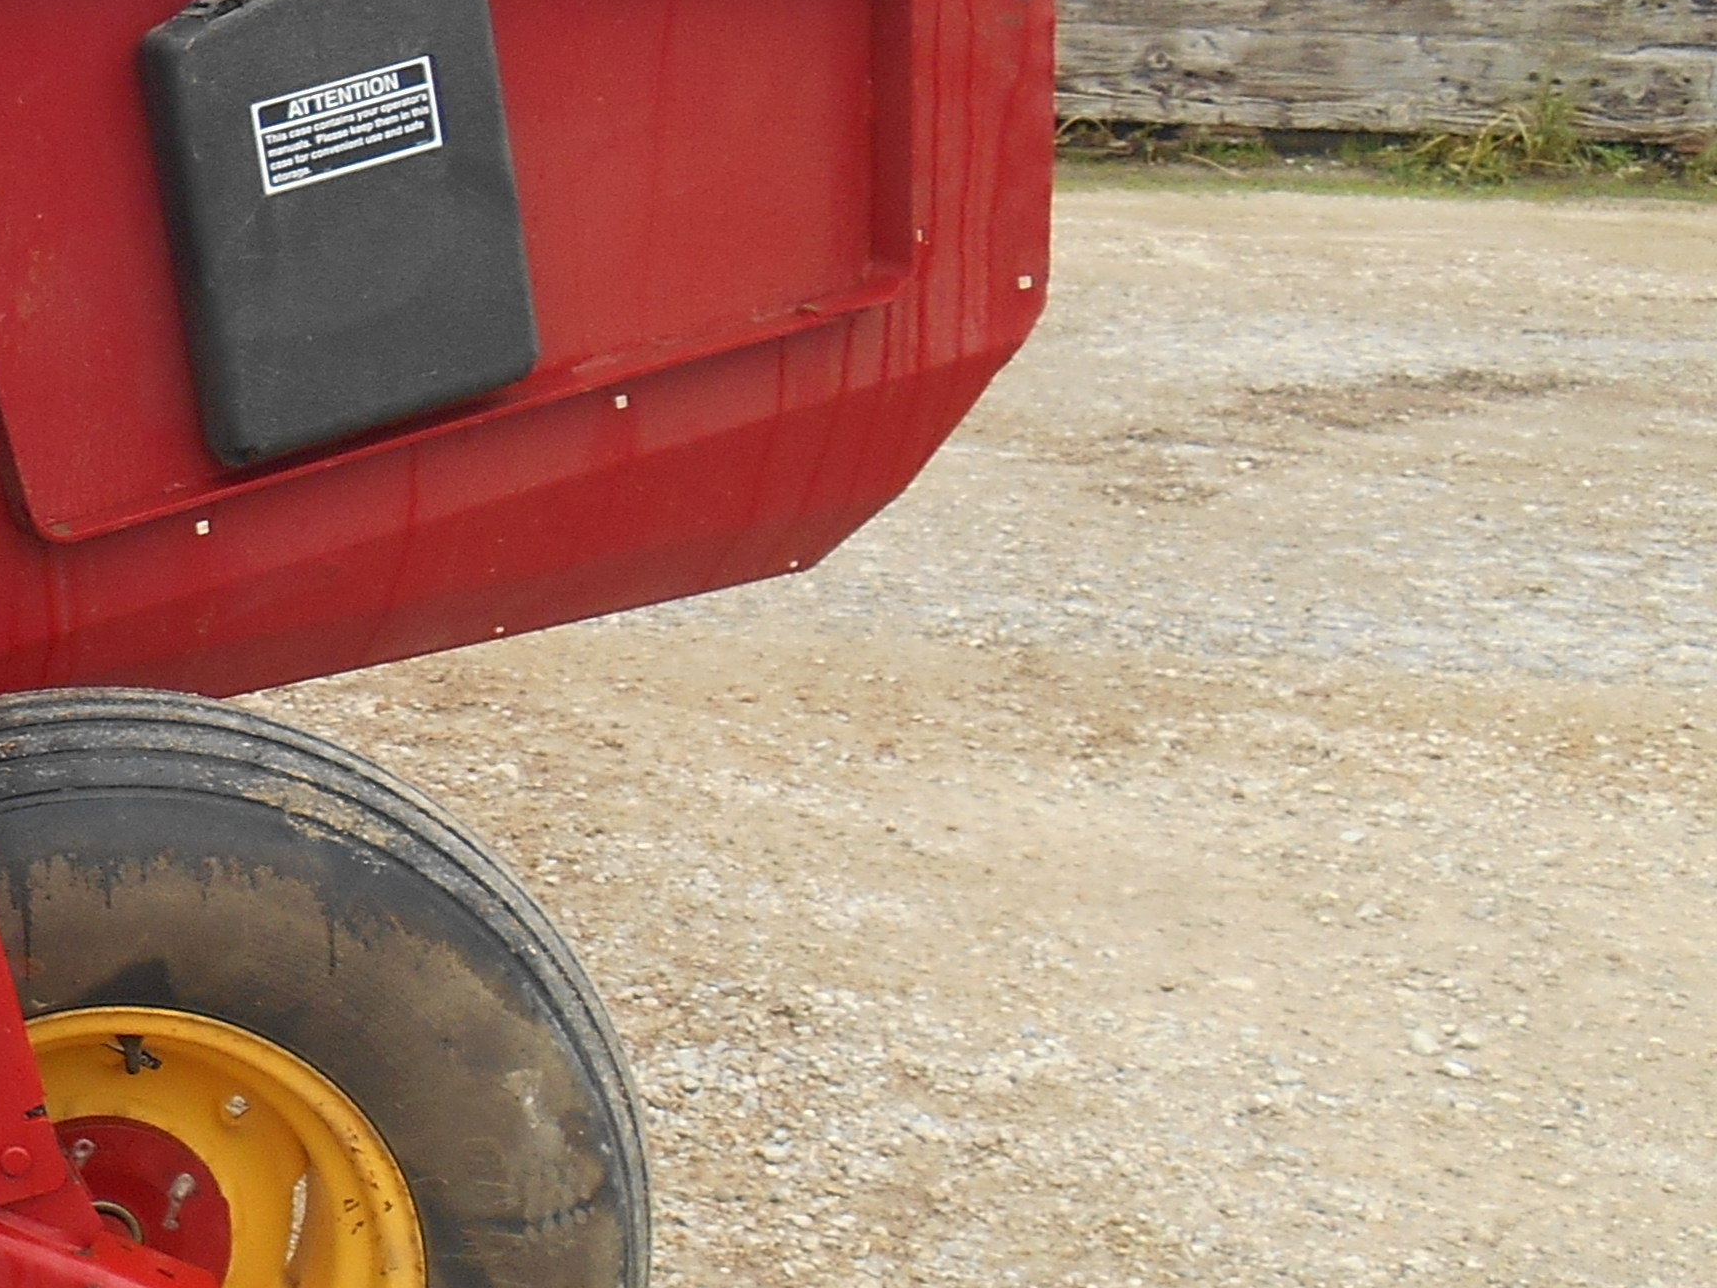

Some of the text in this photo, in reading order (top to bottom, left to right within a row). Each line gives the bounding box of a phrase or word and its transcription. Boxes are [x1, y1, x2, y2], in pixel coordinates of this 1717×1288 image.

[265, 93, 428, 145] This case contains your operator's
[287, 72, 400, 119] ATTENTION
[267, 105, 430, 158] manuals. Please keep them in this
[270, 158, 293, 171] case
[294, 153, 309, 164] for
[310, 136, 364, 160] convenient
[365, 132, 384, 145] use
[384, 125, 403, 139] and
[272, 167, 313, 184] storage.
